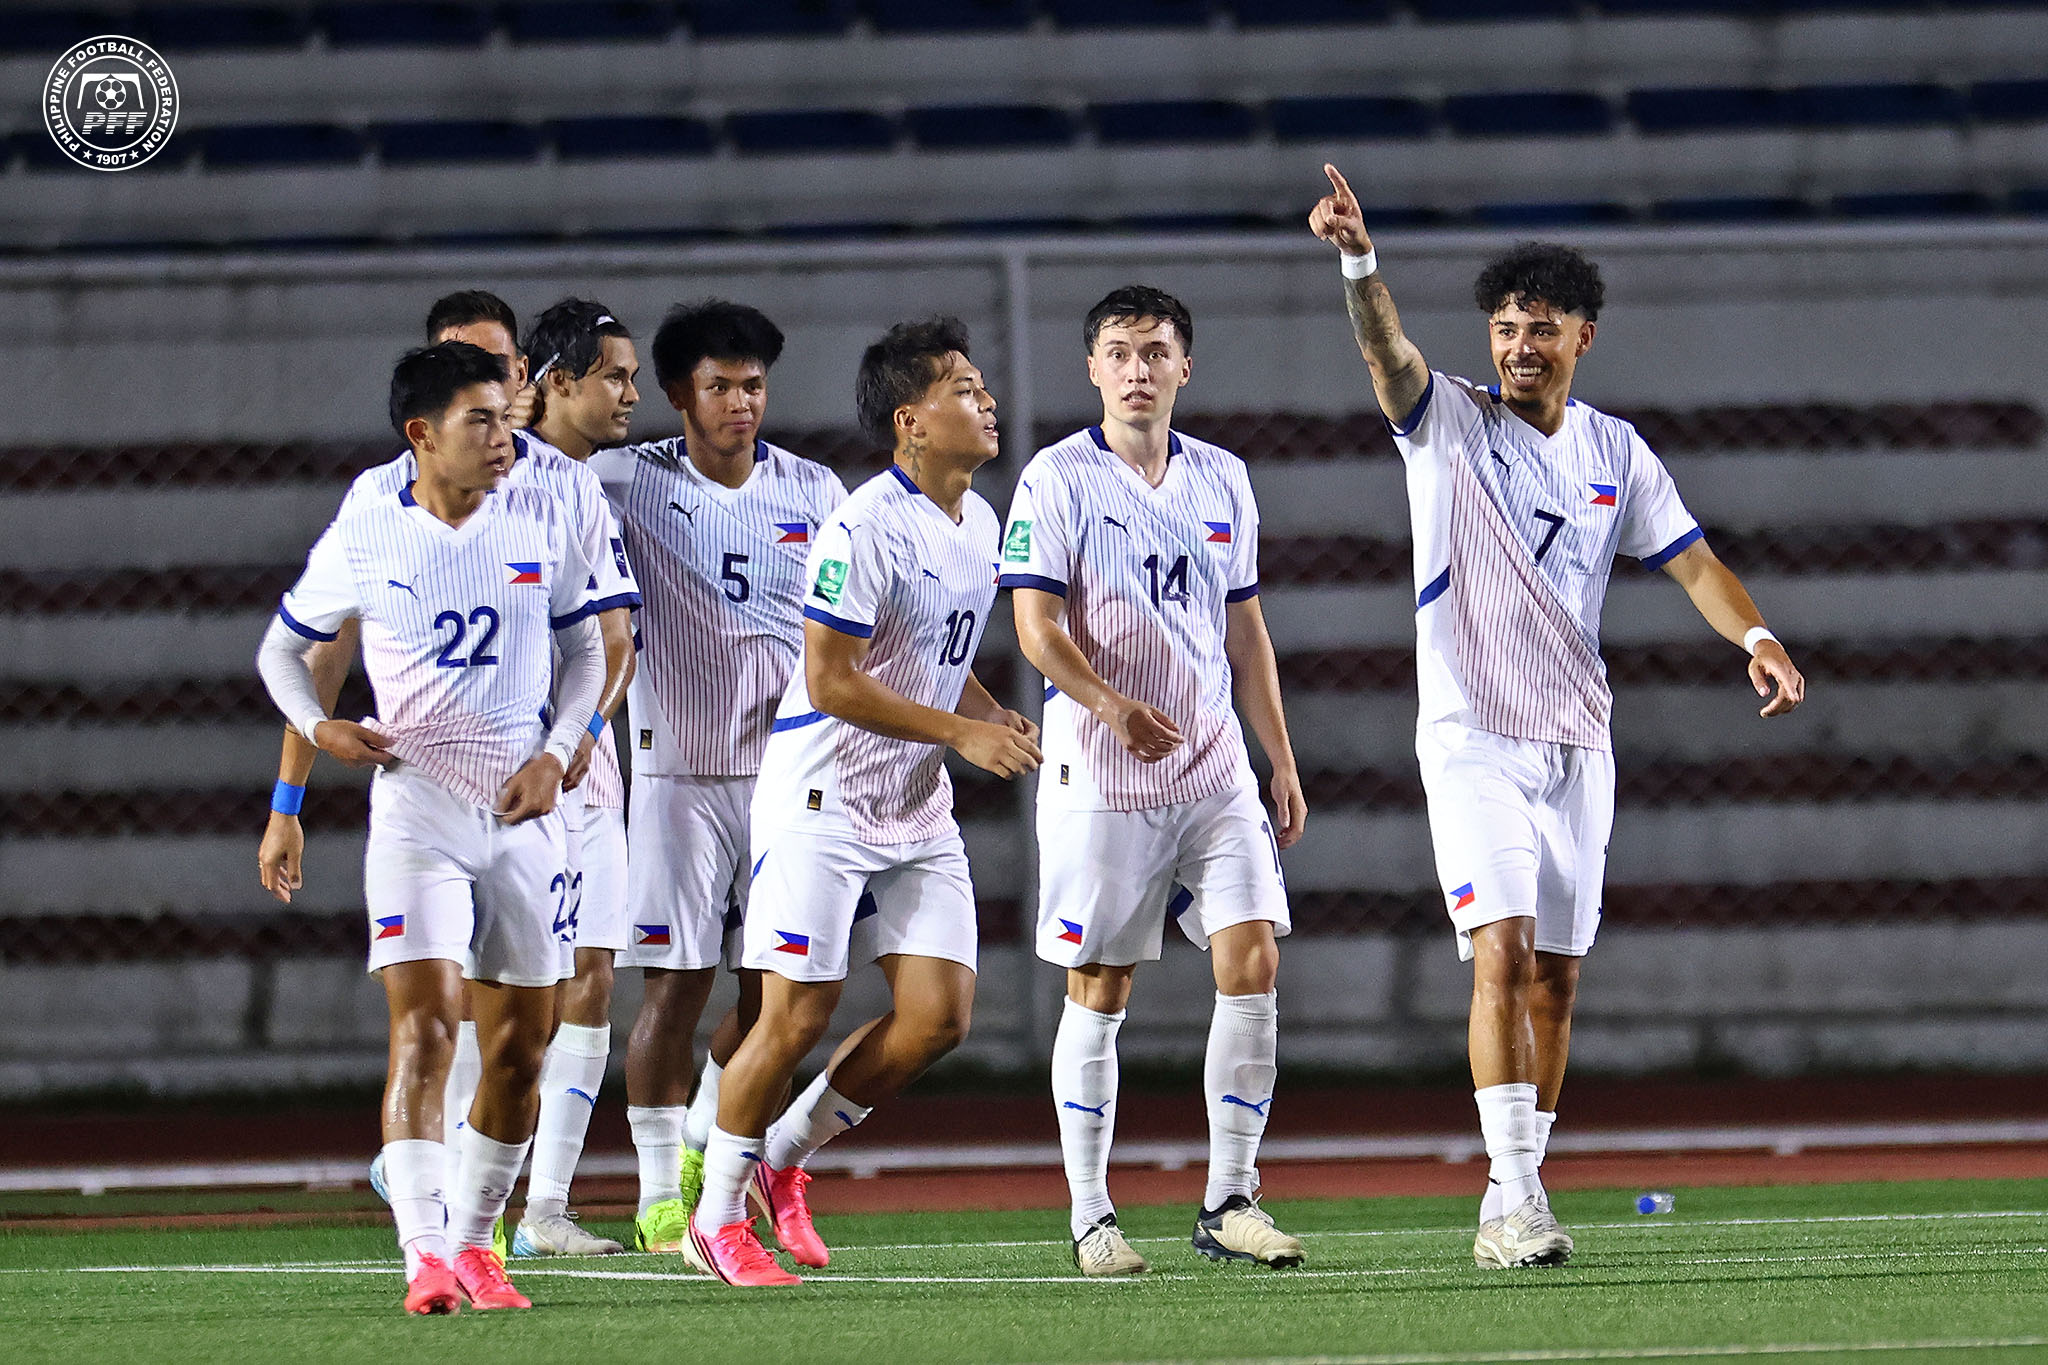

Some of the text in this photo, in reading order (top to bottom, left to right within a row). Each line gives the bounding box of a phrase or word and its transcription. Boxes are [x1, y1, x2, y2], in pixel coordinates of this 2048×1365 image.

[1534, 508, 1566, 567] 7
[722, 552, 750, 603] 5
[1143, 554, 1190, 613] 14
[434, 606, 500, 668] 22
[939, 610, 975, 666] 10
[1260, 820, 1280, 875] 1
[550, 871, 583, 934] 22
